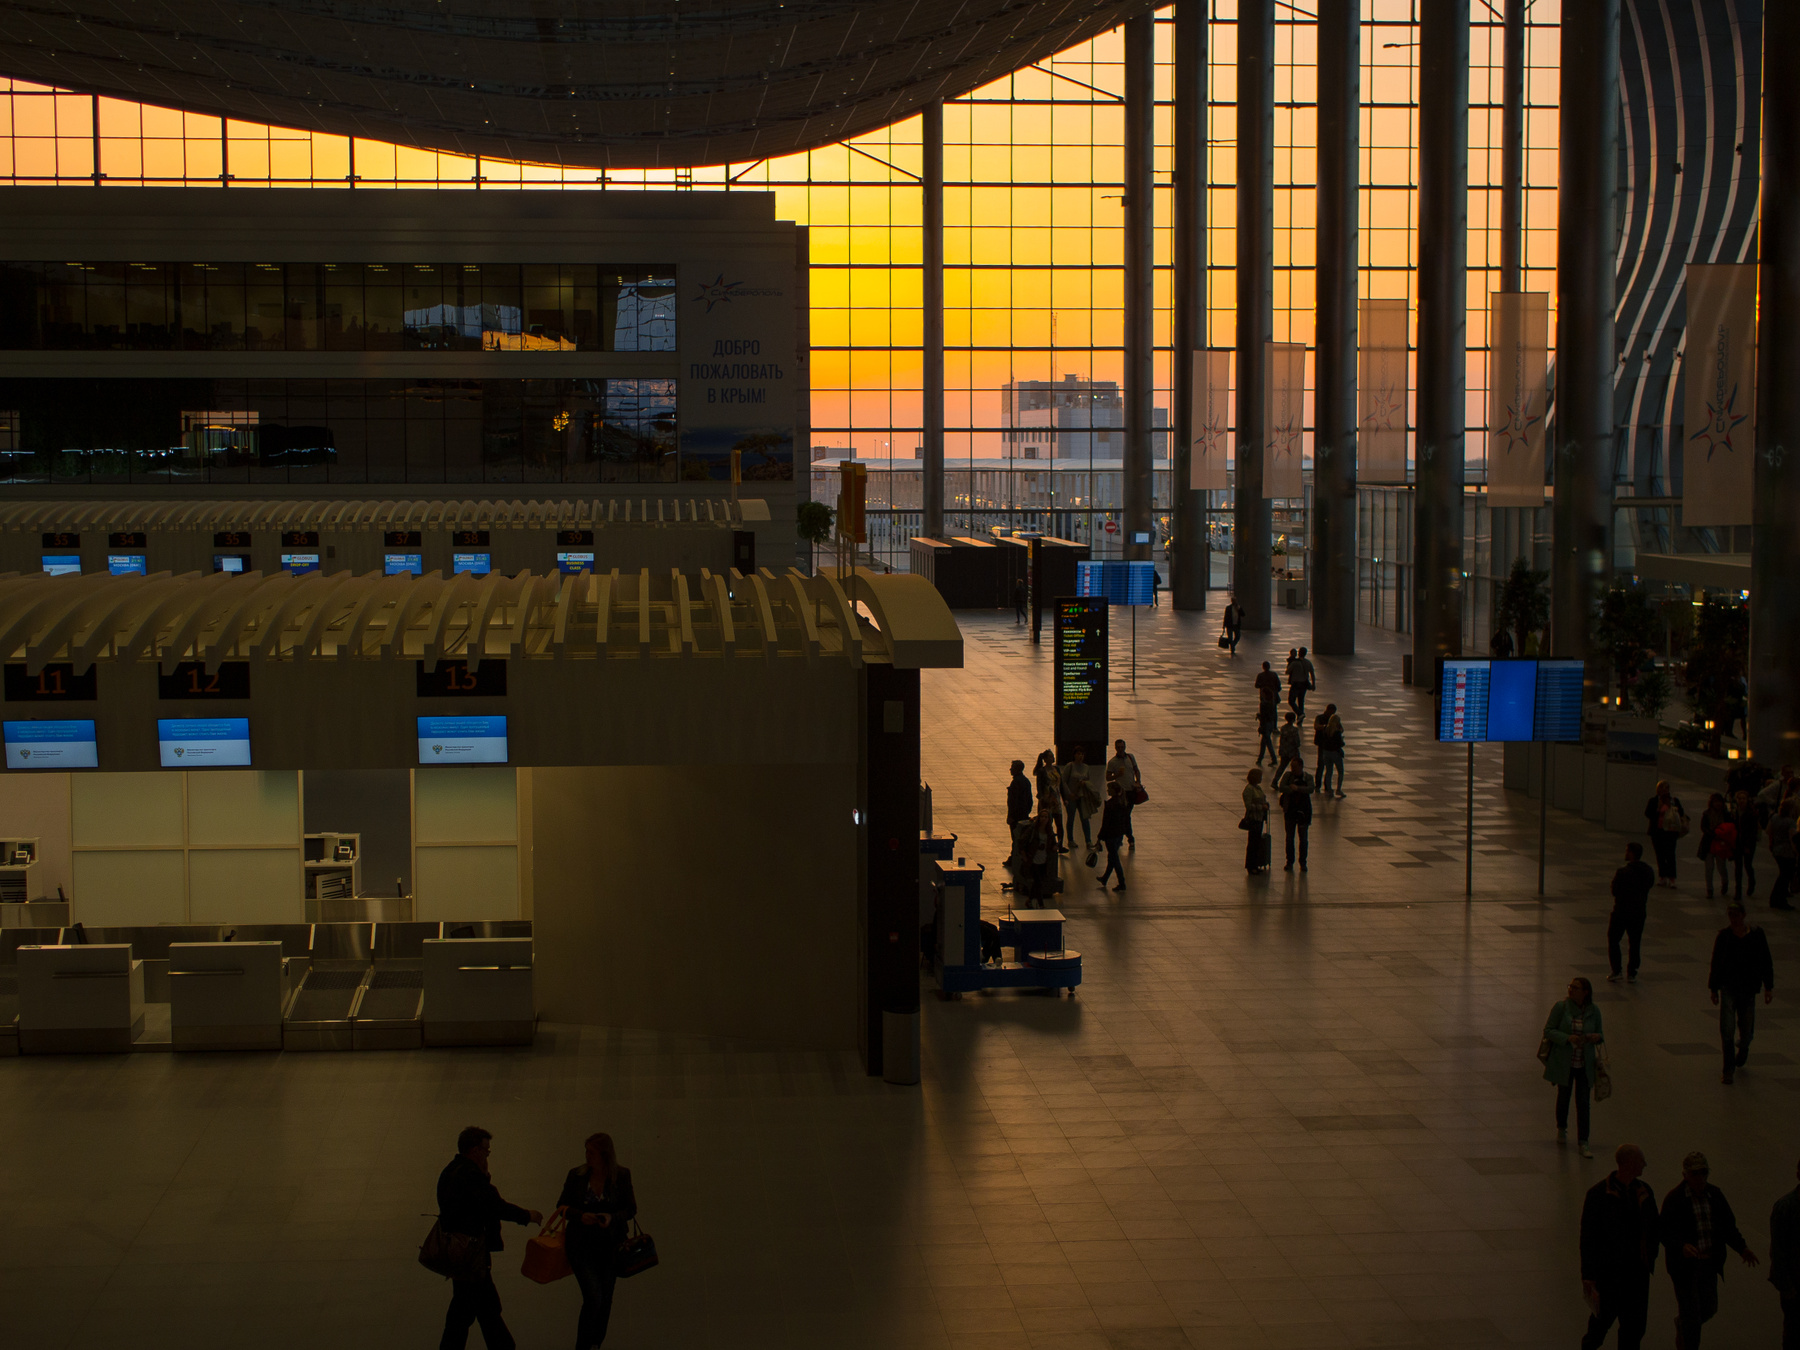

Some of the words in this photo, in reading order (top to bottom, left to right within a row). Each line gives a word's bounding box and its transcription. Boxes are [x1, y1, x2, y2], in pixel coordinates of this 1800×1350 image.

[712, 339, 760, 358] ДОБРО
[690, 363, 783, 379] ПОЖАЛОВАТЬ
[707, 388, 716, 403] В
[721, 388, 766, 403] КРЫМ!
[54, 534, 69, 546] 33
[119, 534, 135, 545] 34
[225, 534, 240, 545] 35
[292, 533, 308, 545] 36
[395, 533, 410, 544] 37
[463, 533, 479, 544] 38
[568, 532, 583, 544] 39
[36, 669, 67, 694] 11
[186, 668, 221, 693] 12
[445, 665, 477, 690] 13
